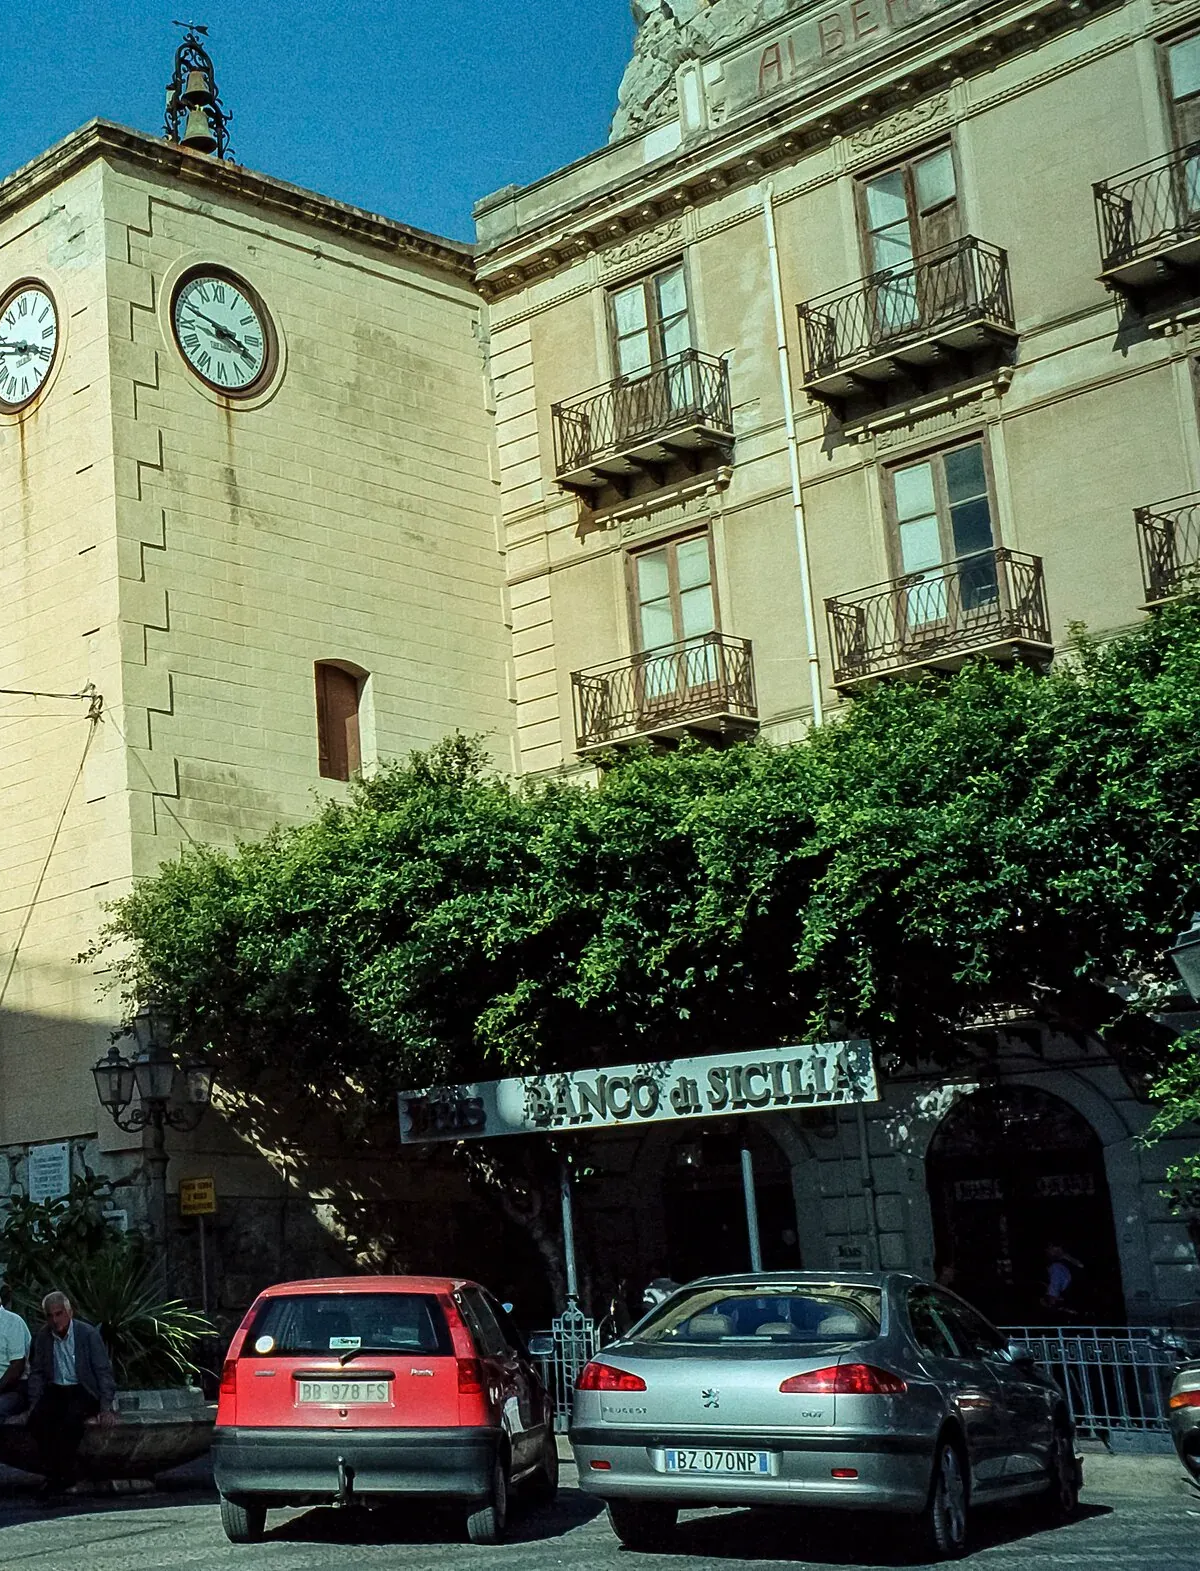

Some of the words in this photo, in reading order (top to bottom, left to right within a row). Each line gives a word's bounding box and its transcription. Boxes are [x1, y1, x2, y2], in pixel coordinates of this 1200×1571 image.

[527, 1076, 660, 1123] BANCO
[670, 1076, 701, 1113] di
[706, 1051, 854, 1109] SICILIA
[303, 1383, 321, 1400] BB
[331, 1383, 360, 1400] 978
[366, 1383, 385, 1400] FS
[677, 1451, 698, 1470] BZ
[703, 1451, 757, 1471] 070NP
